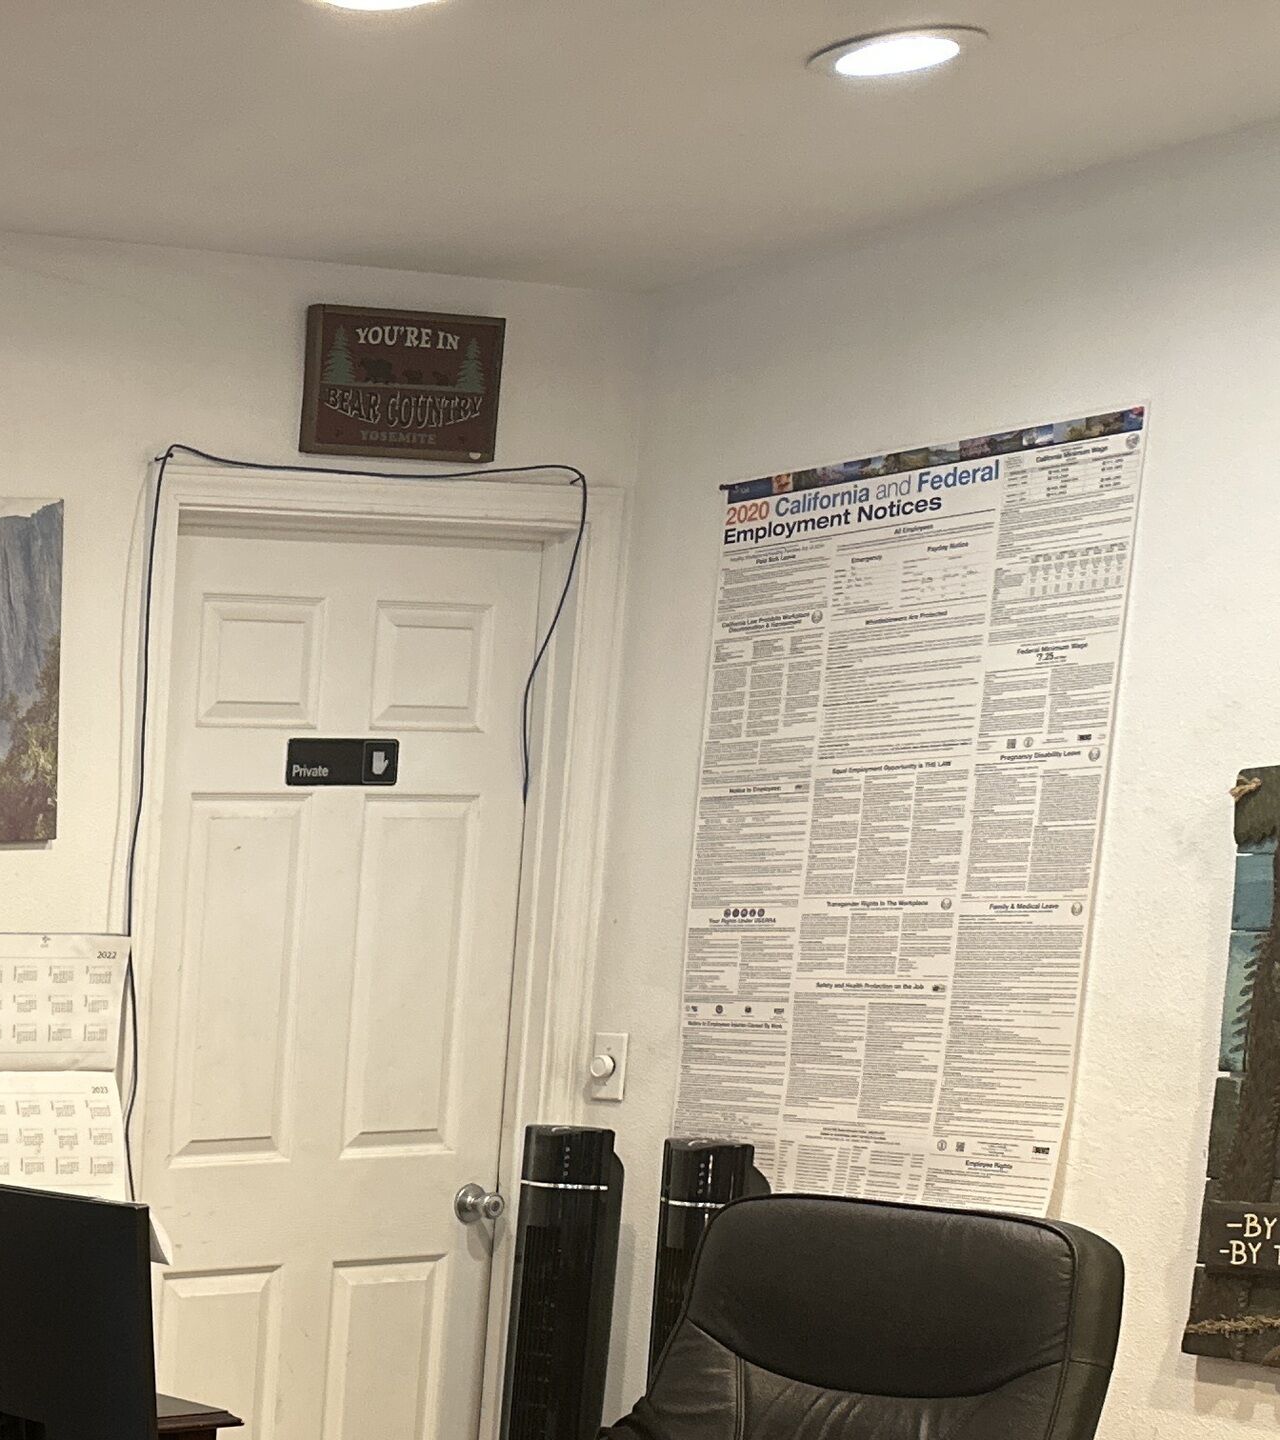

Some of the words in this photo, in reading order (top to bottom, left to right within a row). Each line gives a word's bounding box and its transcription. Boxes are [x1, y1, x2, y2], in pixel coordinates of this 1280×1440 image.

[355, 325, 432, 349] YOU'RE
[436, 332, 460, 350] IN
[324, 388, 382, 425] BEAR
[387, 391, 483, 429] COUNTRY
[360, 430, 437, 445] YOSEMITE
[725, 500, 770, 526] 2020
[774, 484, 870, 517] California
[875, 475, 912, 500] and
[917, 459, 1000, 492] Federal
[724, 507, 852, 545] Employment
[857, 496, 942, 523] Notices
[292, 764, 329, 777] Private
[96, 951, 117, 961] 2022
[91, 1086, 109, 1095] 2023
